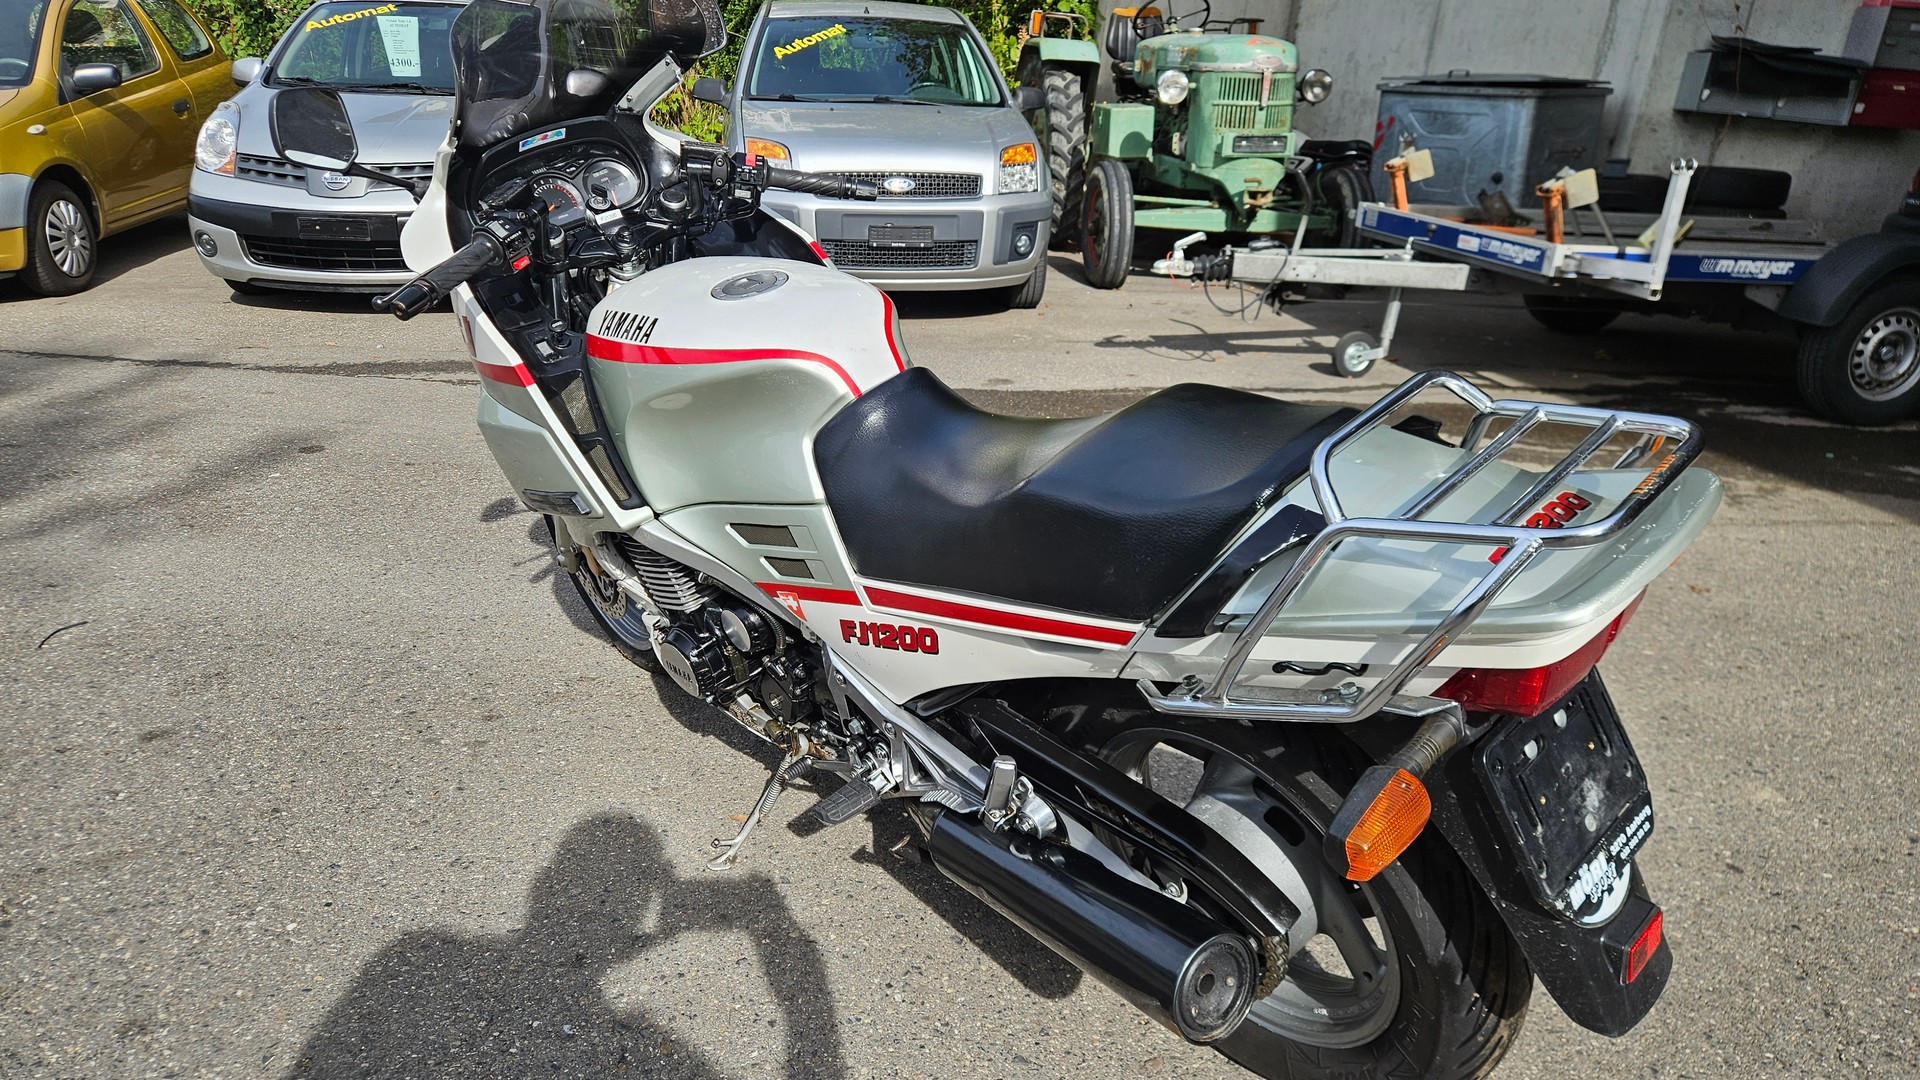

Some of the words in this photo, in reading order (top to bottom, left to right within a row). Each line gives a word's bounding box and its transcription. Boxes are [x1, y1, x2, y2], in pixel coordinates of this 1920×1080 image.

[305, 3, 398, 32] Automat
[773, 23, 847, 60] Automat
[390, 58, 419, 67] 4300.-
[598, 309, 659, 344] YAMAHA
[839, 619, 940, 655] FJ1200
[1625, 804, 1652, 838] Aarberg
[1590, 861, 1618, 904] SPORT
